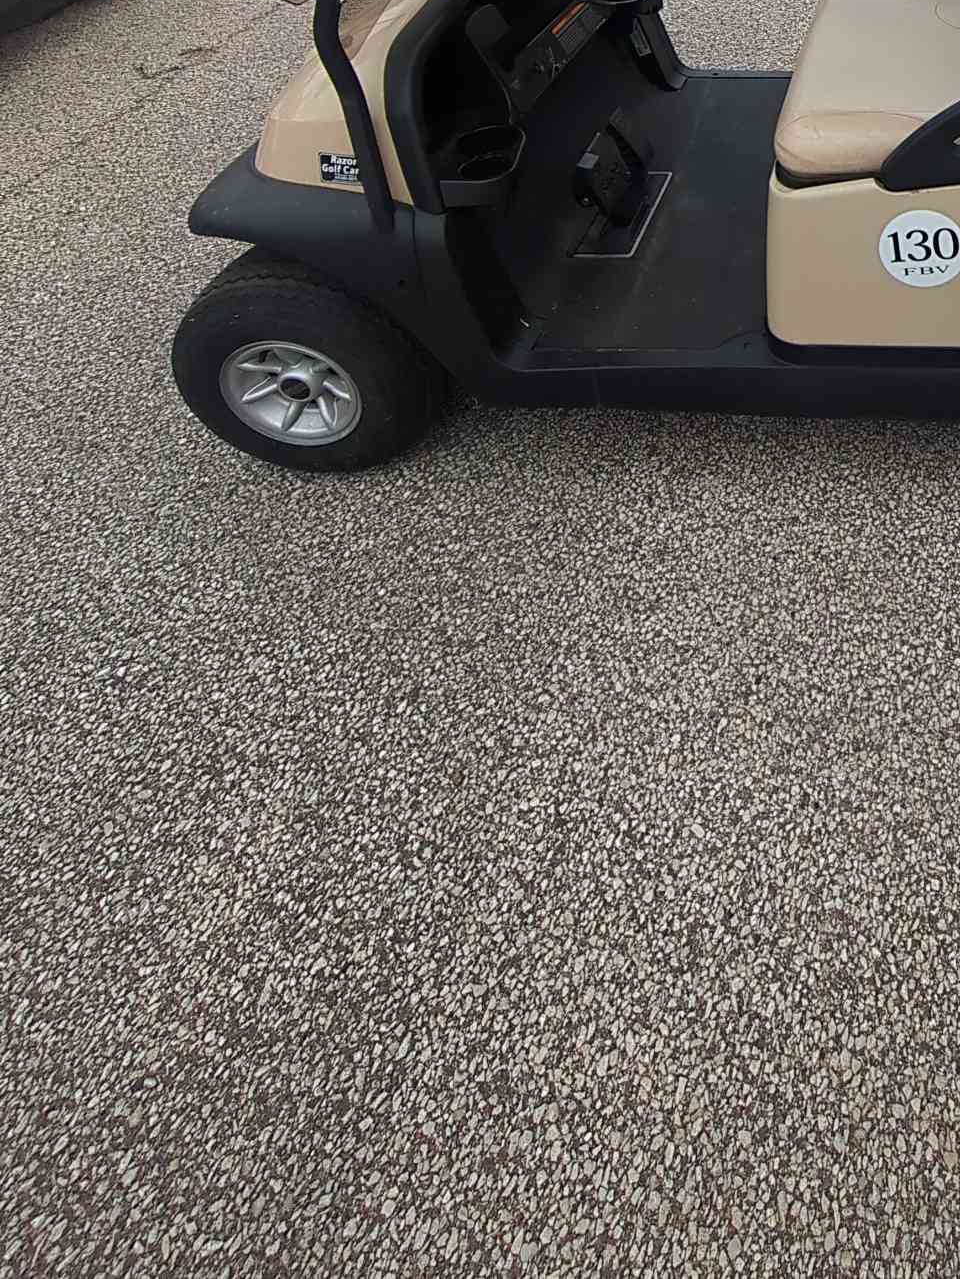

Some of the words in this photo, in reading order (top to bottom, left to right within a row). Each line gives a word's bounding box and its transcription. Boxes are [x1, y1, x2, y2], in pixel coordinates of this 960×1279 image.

[330, 154, 357, 166] Razor
[322, 163, 341, 172] Golf
[343, 165, 360, 175] Car
[887, 227, 960, 263] 130
[903, 265, 950, 276] FBV
